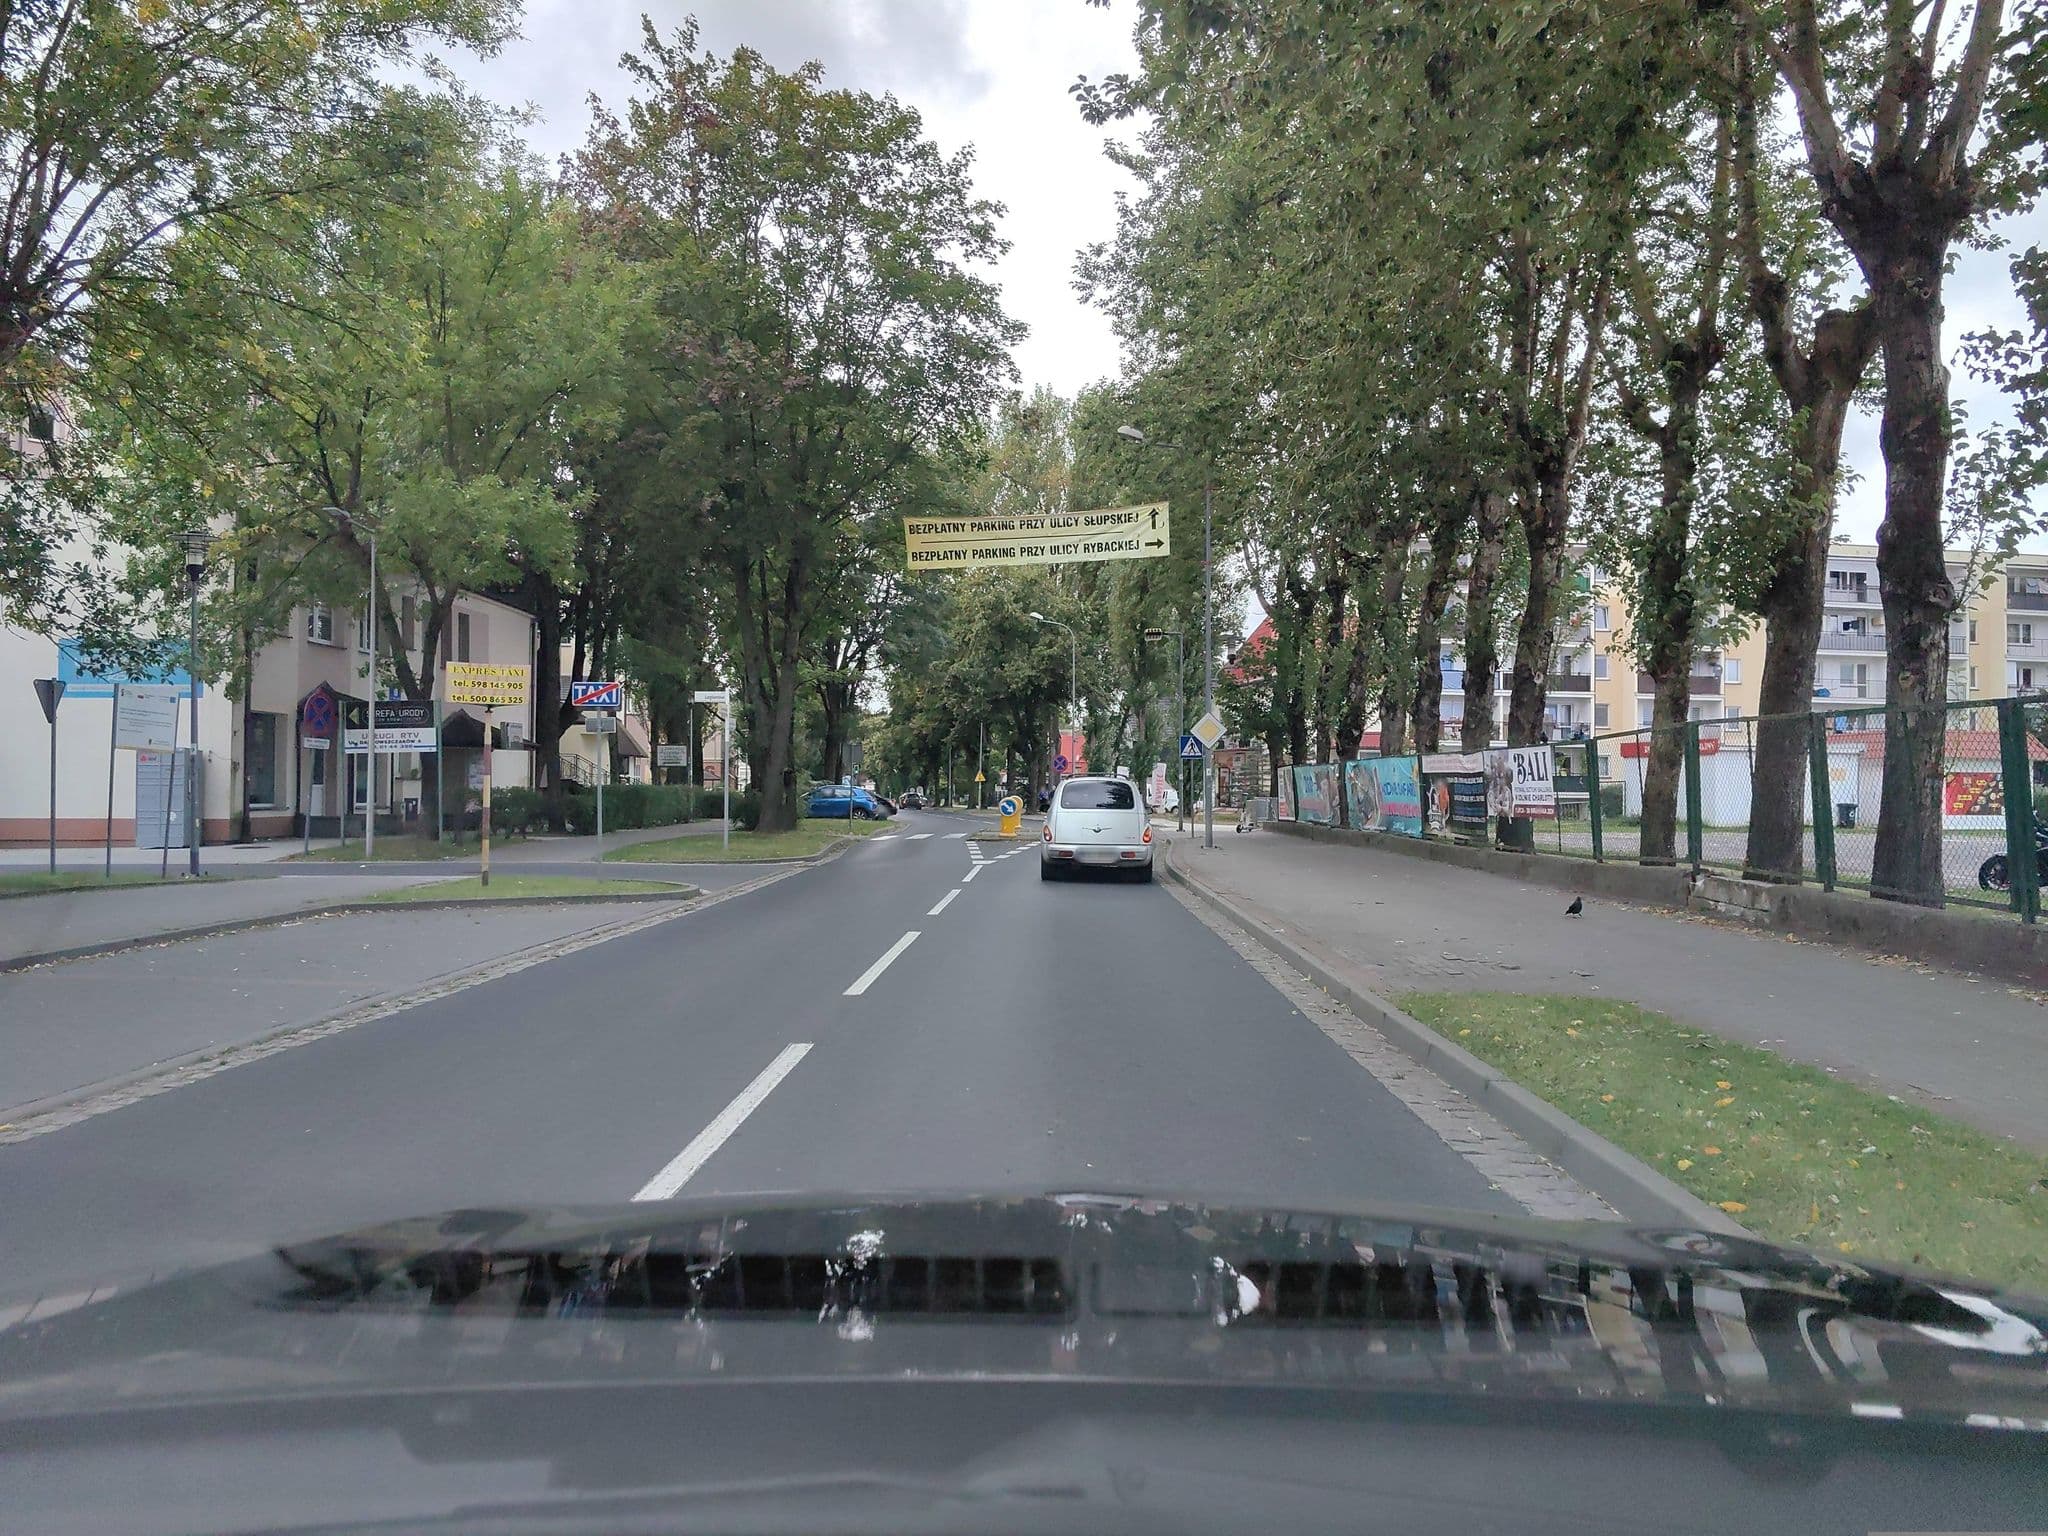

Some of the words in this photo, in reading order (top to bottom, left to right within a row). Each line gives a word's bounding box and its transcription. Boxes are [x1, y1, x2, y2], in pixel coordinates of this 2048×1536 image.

[908, 522, 966, 535] BEZPŁATNY
[970, 520, 1015, 532] PARKING
[1019, 518, 1046, 530] PRZY
[1050, 516, 1080, 529] ULICY
[1083, 512, 1139, 526] SŁUPSKIEJ
[911, 549, 968, 562] BEZPŁATNY
[972, 547, 1016, 559] PARKING
[1020, 545, 1046, 557] PRZY
[1050, 543, 1080, 556] ULICY
[1083, 539, 1140, 553] RYBACKIEJ
[453, 666, 497, 676] EXPRES
[501, 668, 524, 677] TAXI
[453, 680, 469, 688] tel.
[471, 680, 488, 689] 598
[507, 682, 524, 690] 905
[452, 694, 468, 702] tel.
[470, 695, 487, 703] 500
[489, 696, 506, 704] 865
[507, 696, 524, 704] 325
[574, 685, 616, 704] TAXI
[366, 709, 396, 718] SREFA
[398, 709, 425, 717] URODY
[1512, 751, 1549, 785] BALI
